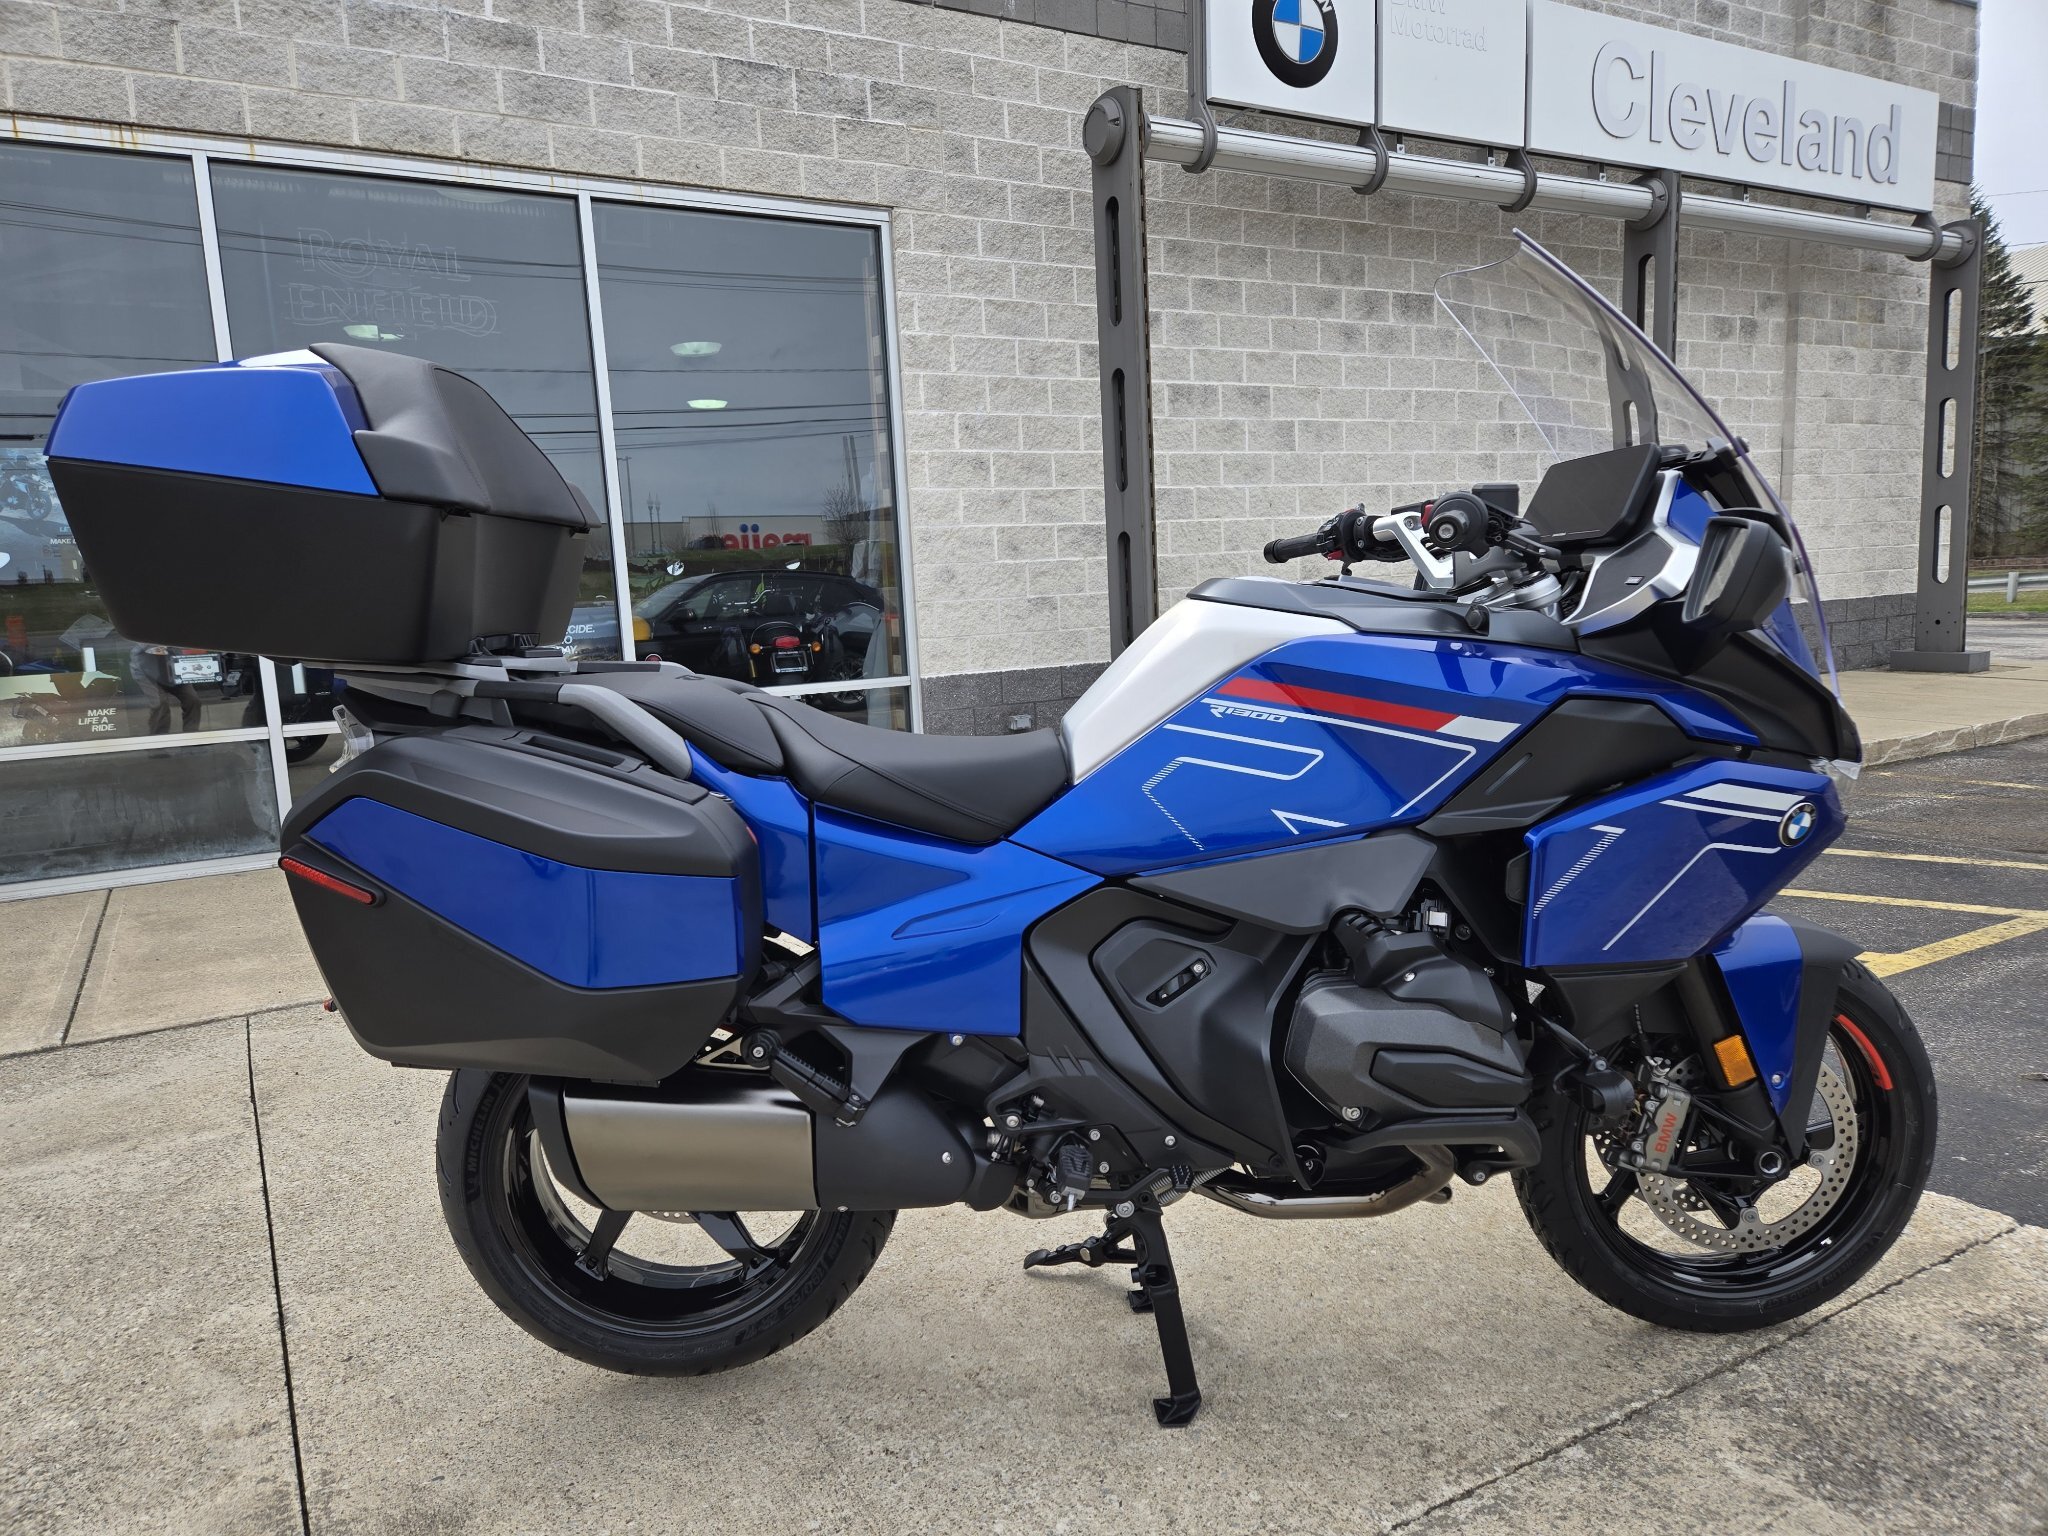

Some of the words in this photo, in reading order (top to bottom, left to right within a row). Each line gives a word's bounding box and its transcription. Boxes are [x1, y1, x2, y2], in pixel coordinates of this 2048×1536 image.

[1391, 8, 1488, 52] Motorrad
[1591, 40, 1902, 184] Cleveland
[297, 227, 471, 282] ROYAL
[288, 283, 497, 337] ENFIELD
[566, 624, 595, 634] CIDE.
[78, 716, 100, 726] LIFE
[100, 716, 109, 724] A
[87, 707, 117, 717] MAKE
[467, 1094, 496, 1174] MICHELIN
[1654, 1112, 1677, 1153] BMW
